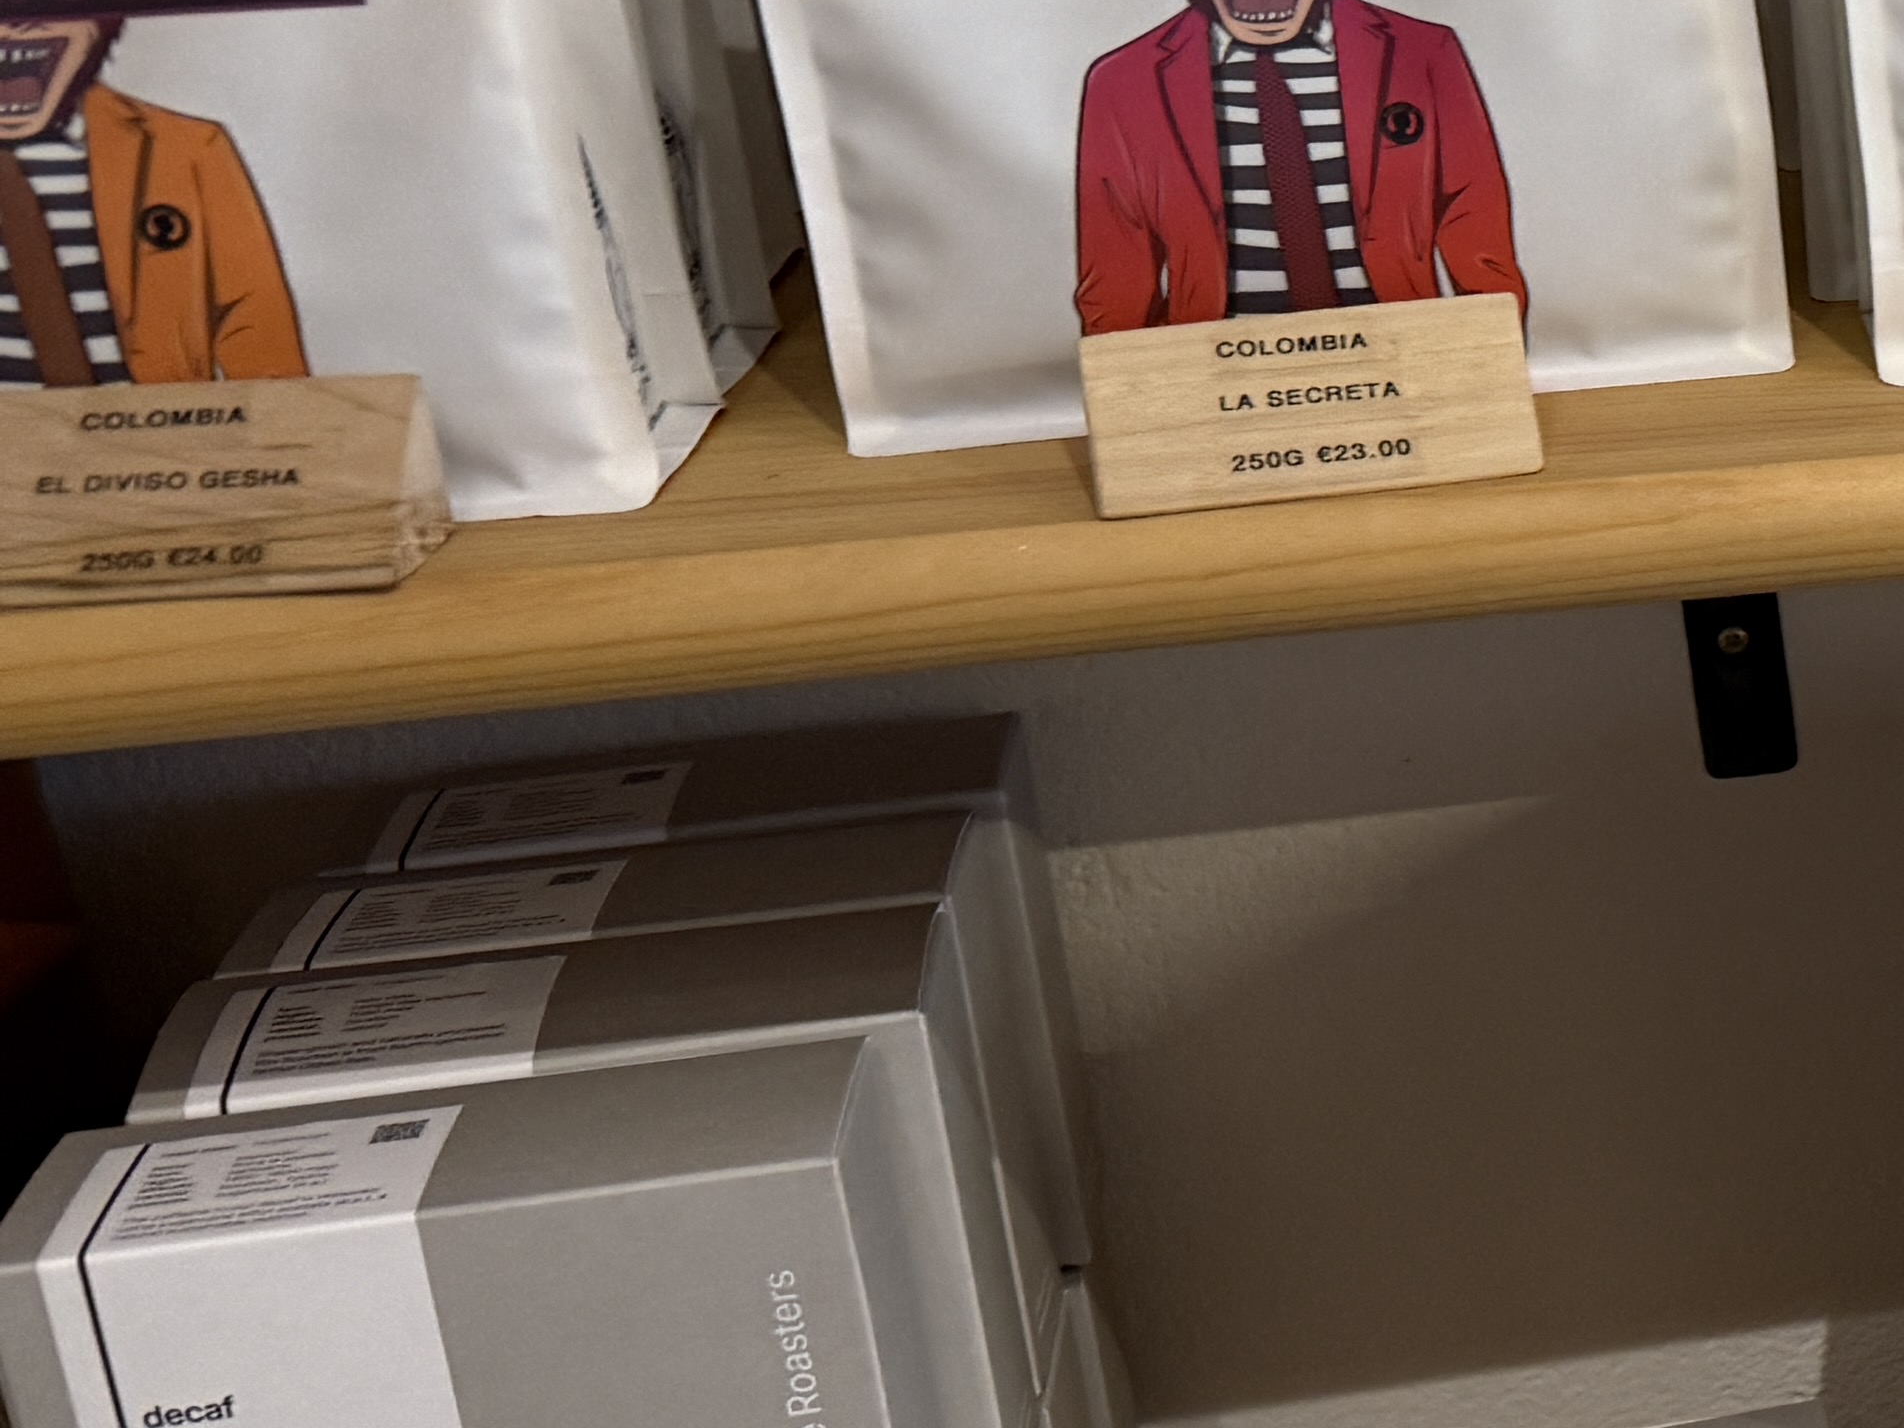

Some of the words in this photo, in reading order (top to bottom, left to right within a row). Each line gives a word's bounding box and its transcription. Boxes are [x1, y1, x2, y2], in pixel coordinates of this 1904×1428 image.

[1216, 333, 1368, 359] COLOMBIA
[1219, 394, 1255, 412] LA
[1267, 381, 1400, 408] SECRETA
[81, 407, 247, 431] COLOMBIA
[1232, 449, 1304, 472] 250G
[1317, 439, 1412, 464] €23.00
[36, 476, 72, 494] EL
[83, 471, 187, 493] DIVISO
[200, 469, 300, 489] GESHA
[82, 549, 155, 572] 250G
[768, 1269, 823, 1418] Roasters
[143, 1395, 235, 1428] decaf
